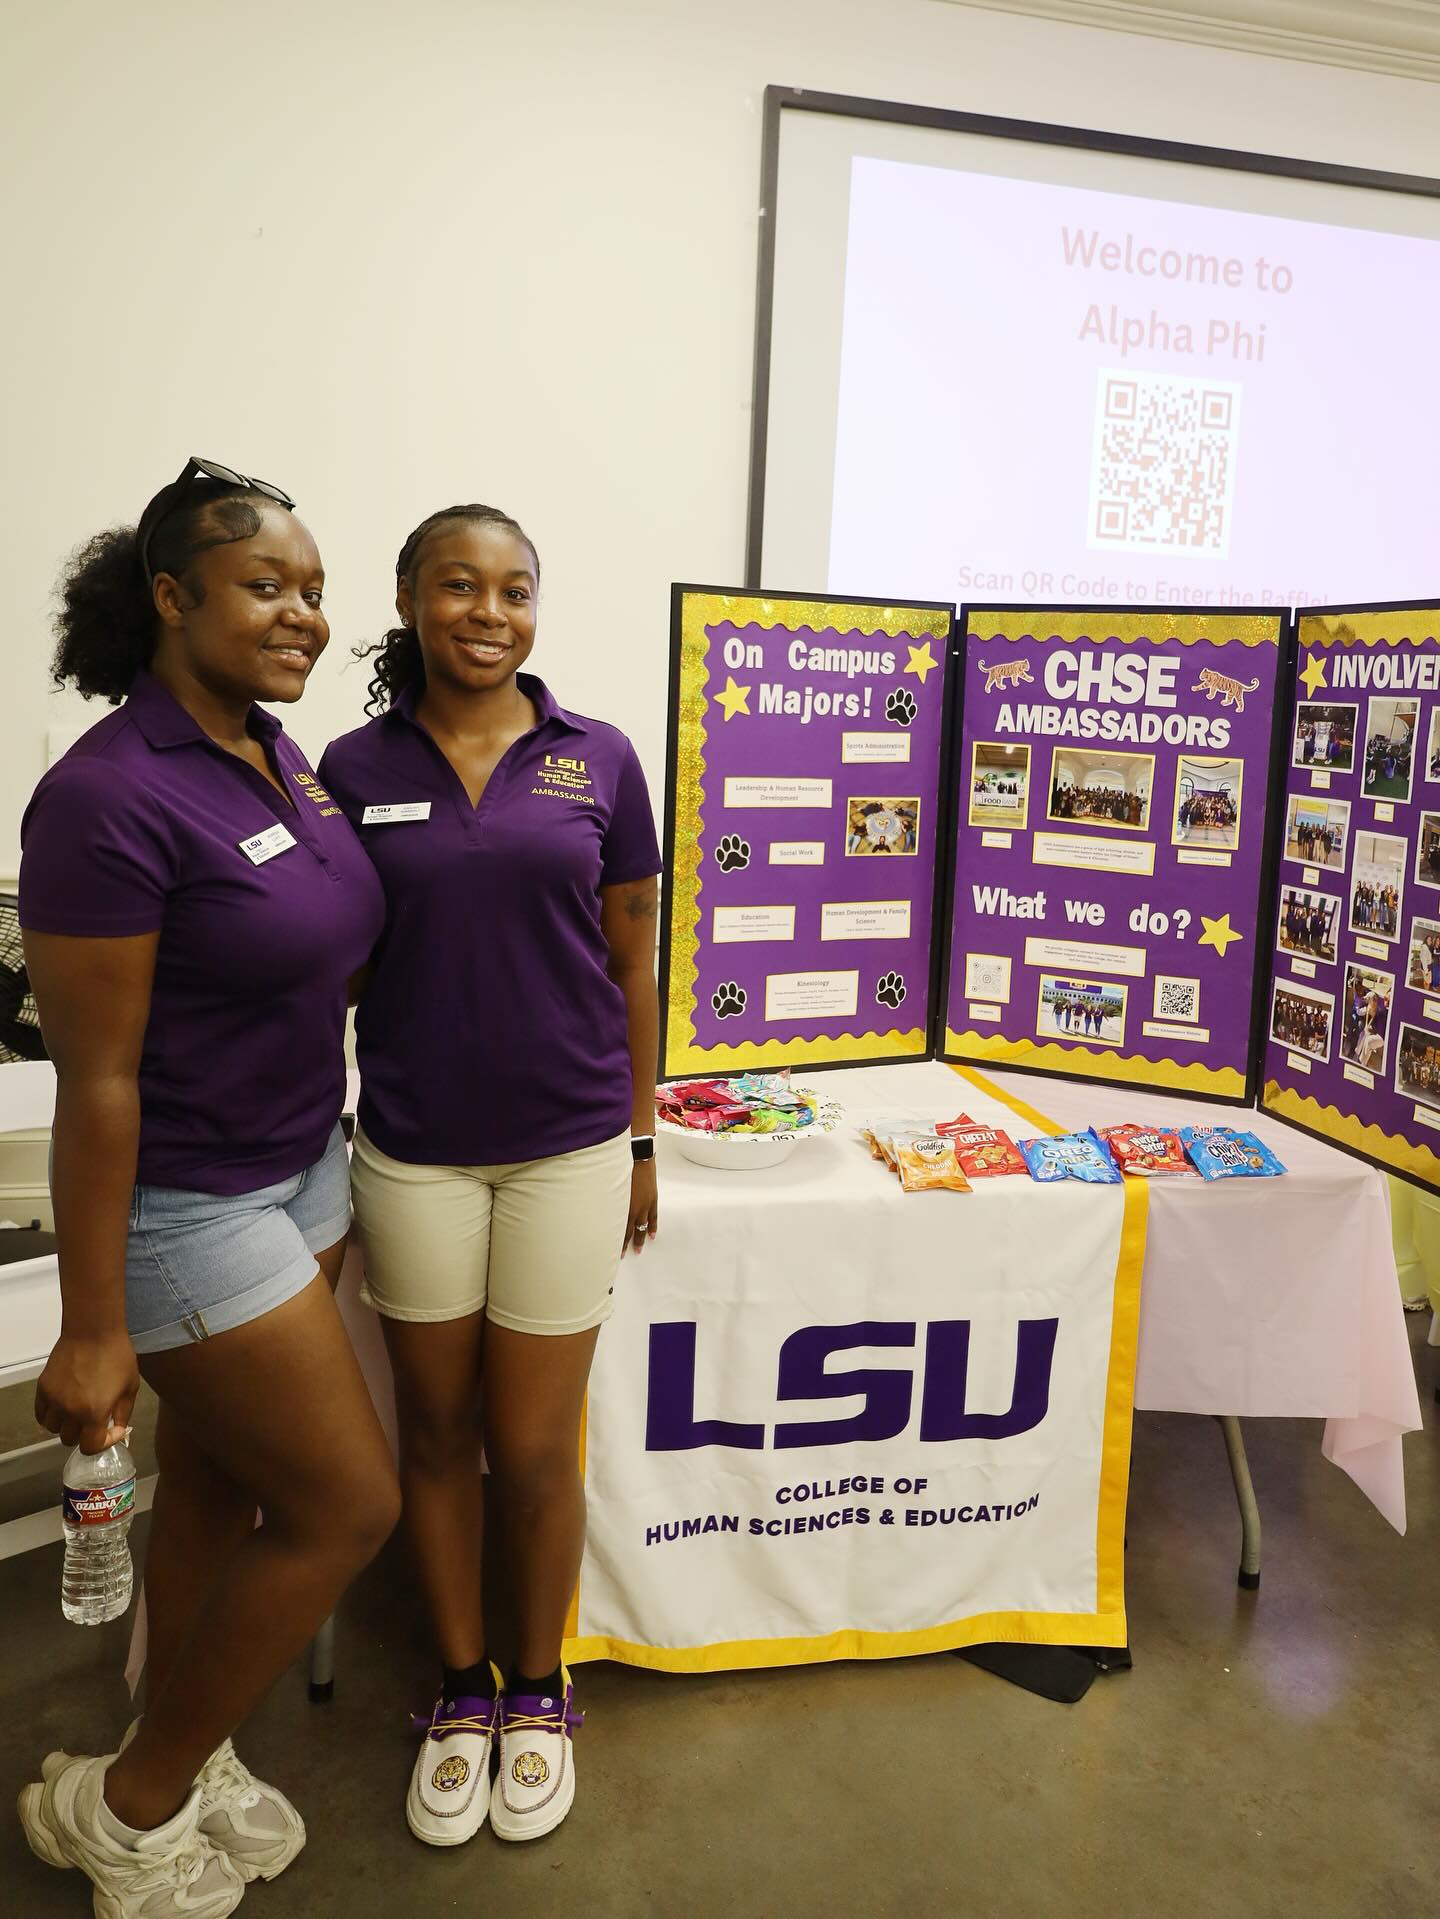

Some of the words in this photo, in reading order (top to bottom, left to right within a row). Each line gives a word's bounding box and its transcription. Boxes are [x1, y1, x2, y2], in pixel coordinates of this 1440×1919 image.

[1061, 226, 1244, 288] Welcome
[1254, 255, 1295, 295] to
[1078, 303, 1194, 358] Alpha
[1206, 318, 1268, 363] Phi
[958, 566, 1014, 593] Scan
[1021, 570, 1054, 598] QR
[1061, 573, 1118, 599] Code
[1126, 578, 1148, 602] to
[1154, 581, 1213, 605] Enter
[1219, 584, 1254, 606] the
[723, 637, 764, 669] On
[787, 639, 896, 679] Campus
[1043, 649, 1181, 708] CHSE
[758, 683, 873, 725] Majors!
[994, 703, 1232, 750] AMBASSADORS
[545, 755, 586, 772] LSU
[537, 770, 561, 779] Human
[562, 775, 592, 785] Sciences
[551, 777, 585, 790] Education
[531, 787, 595, 806] AMBASSADOR
[735, 784, 768, 792] Leadership
[246, 839, 262, 851] LSU
[971, 884, 1047, 920] What
[1064, 899, 1106, 926] we
[1128, 902, 1192, 940] do?
[916, 1141, 945, 1151] Goldfish
[960, 1131, 999, 1144] CHEEZ-IT
[1128, 1134, 1160, 1147] Nutter
[1042, 1145, 1094, 1158] OREO
[1207, 1142, 1234, 1158] Chips
[645, 1317, 1059, 1452] LSU
[775, 1475, 885, 1505] COLLEGE
[893, 1478, 928, 1496] OF
[76, 1499, 117, 1511] OZARKA
[645, 1513, 740, 1547] HUMAN
[748, 1507, 871, 1538] SCIENCES
[878, 1508, 895, 1526] &
[904, 1492, 1040, 1527] EDUCATION
